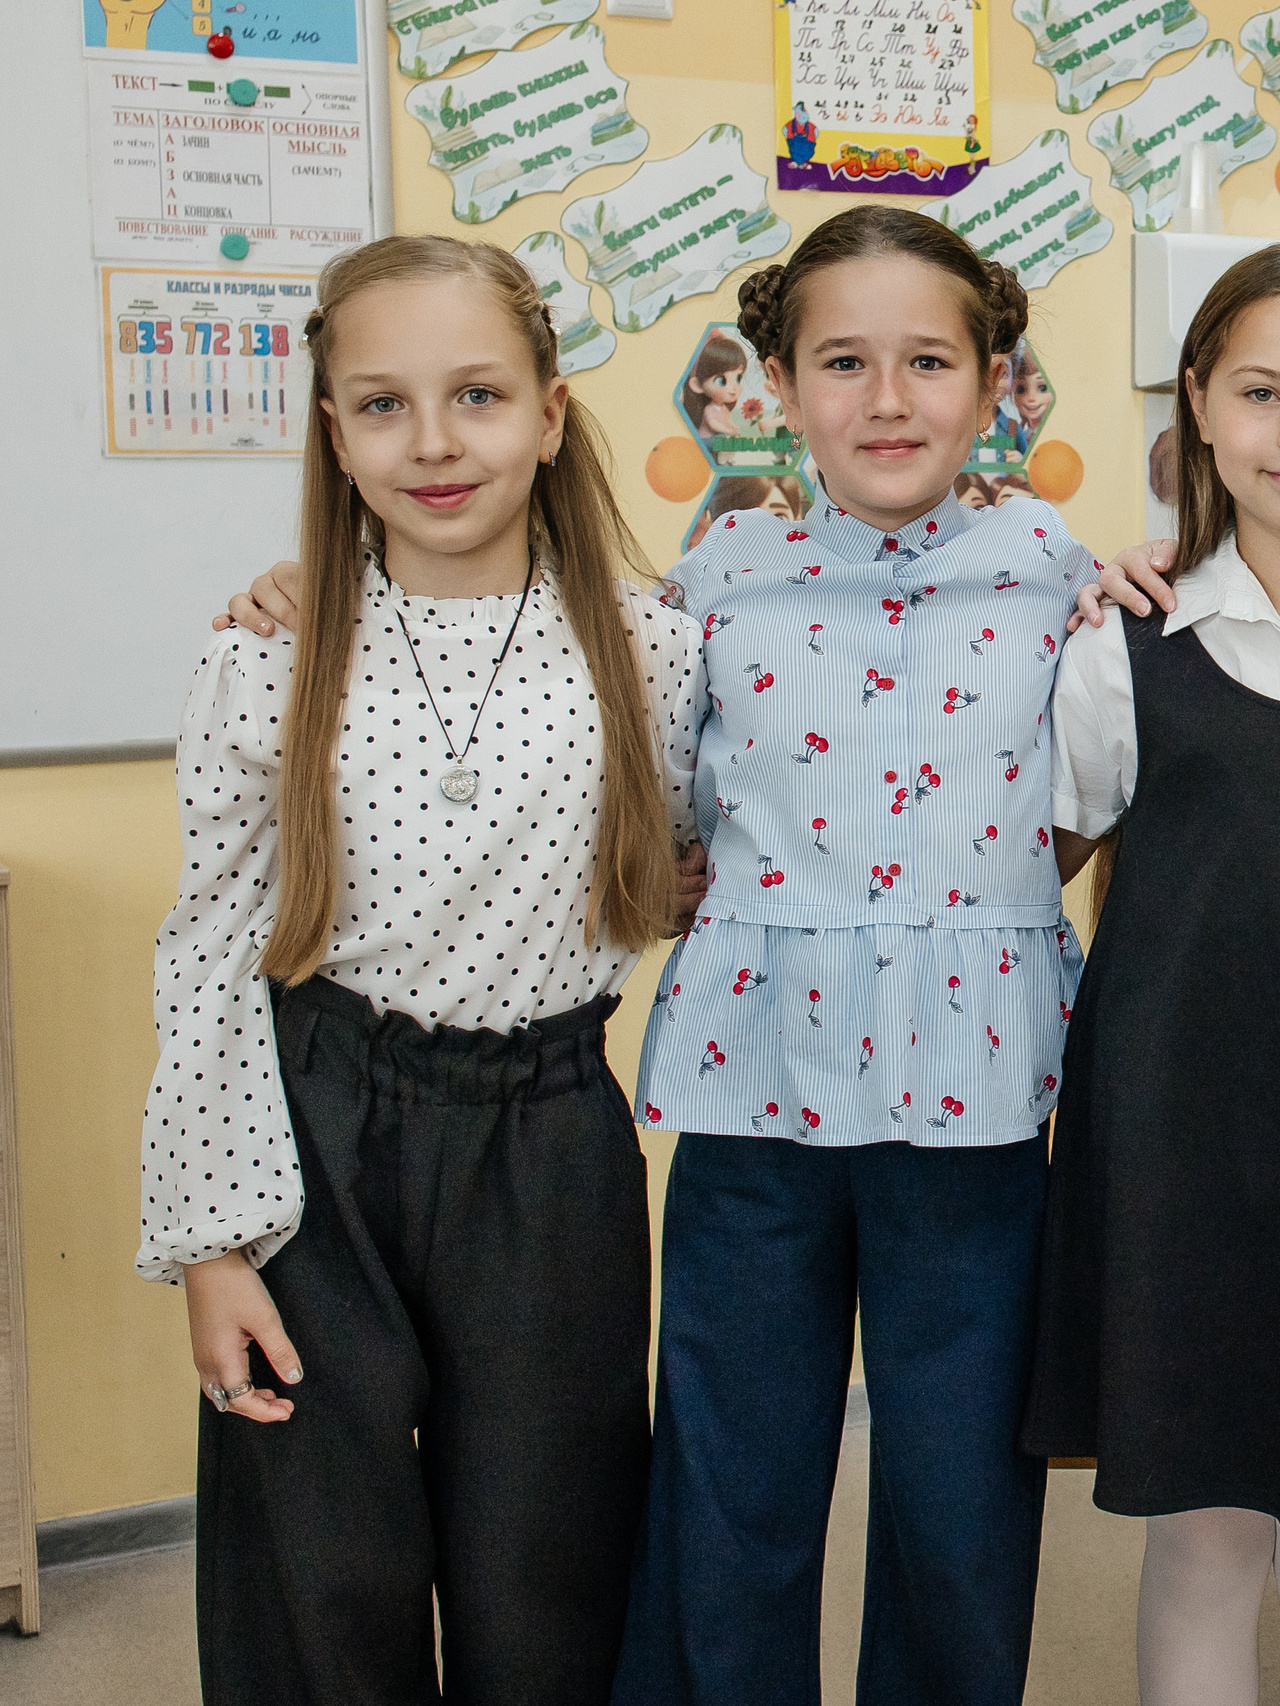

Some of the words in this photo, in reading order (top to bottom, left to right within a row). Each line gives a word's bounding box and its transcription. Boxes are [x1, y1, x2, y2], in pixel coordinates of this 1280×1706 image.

[793, 27, 822, 49] Пп
[856, 32, 874, 53] Сс
[112, 74, 158, 91] ТЕКСТ
[517, 59, 589, 97] книжки
[796, 63, 828, 86] Хх
[113, 111, 155, 127] ТЕМА
[161, 114, 264, 133] ЗАГОЛОВОК
[272, 122, 360, 139] ОСНОВНАЯ
[182, 135, 210, 148] ЗАЧИН
[287, 140, 347, 156] МЫСЛЬ
[183, 170, 233, 184] ОСНОВНАЯ
[234, 173, 263, 186] ЧАСТЬ
[184, 205, 233, 219] КОНЦОВКА
[118, 221, 209, 237] ПОВЕСТВОВАНИЕ
[290, 230, 363, 243] РАССУЖДЕНИЕ
[167, 280, 211, 294] КЛАССЫ
[214, 282, 222, 294] И
[224, 282, 276, 297] РАЗРЯДЫ
